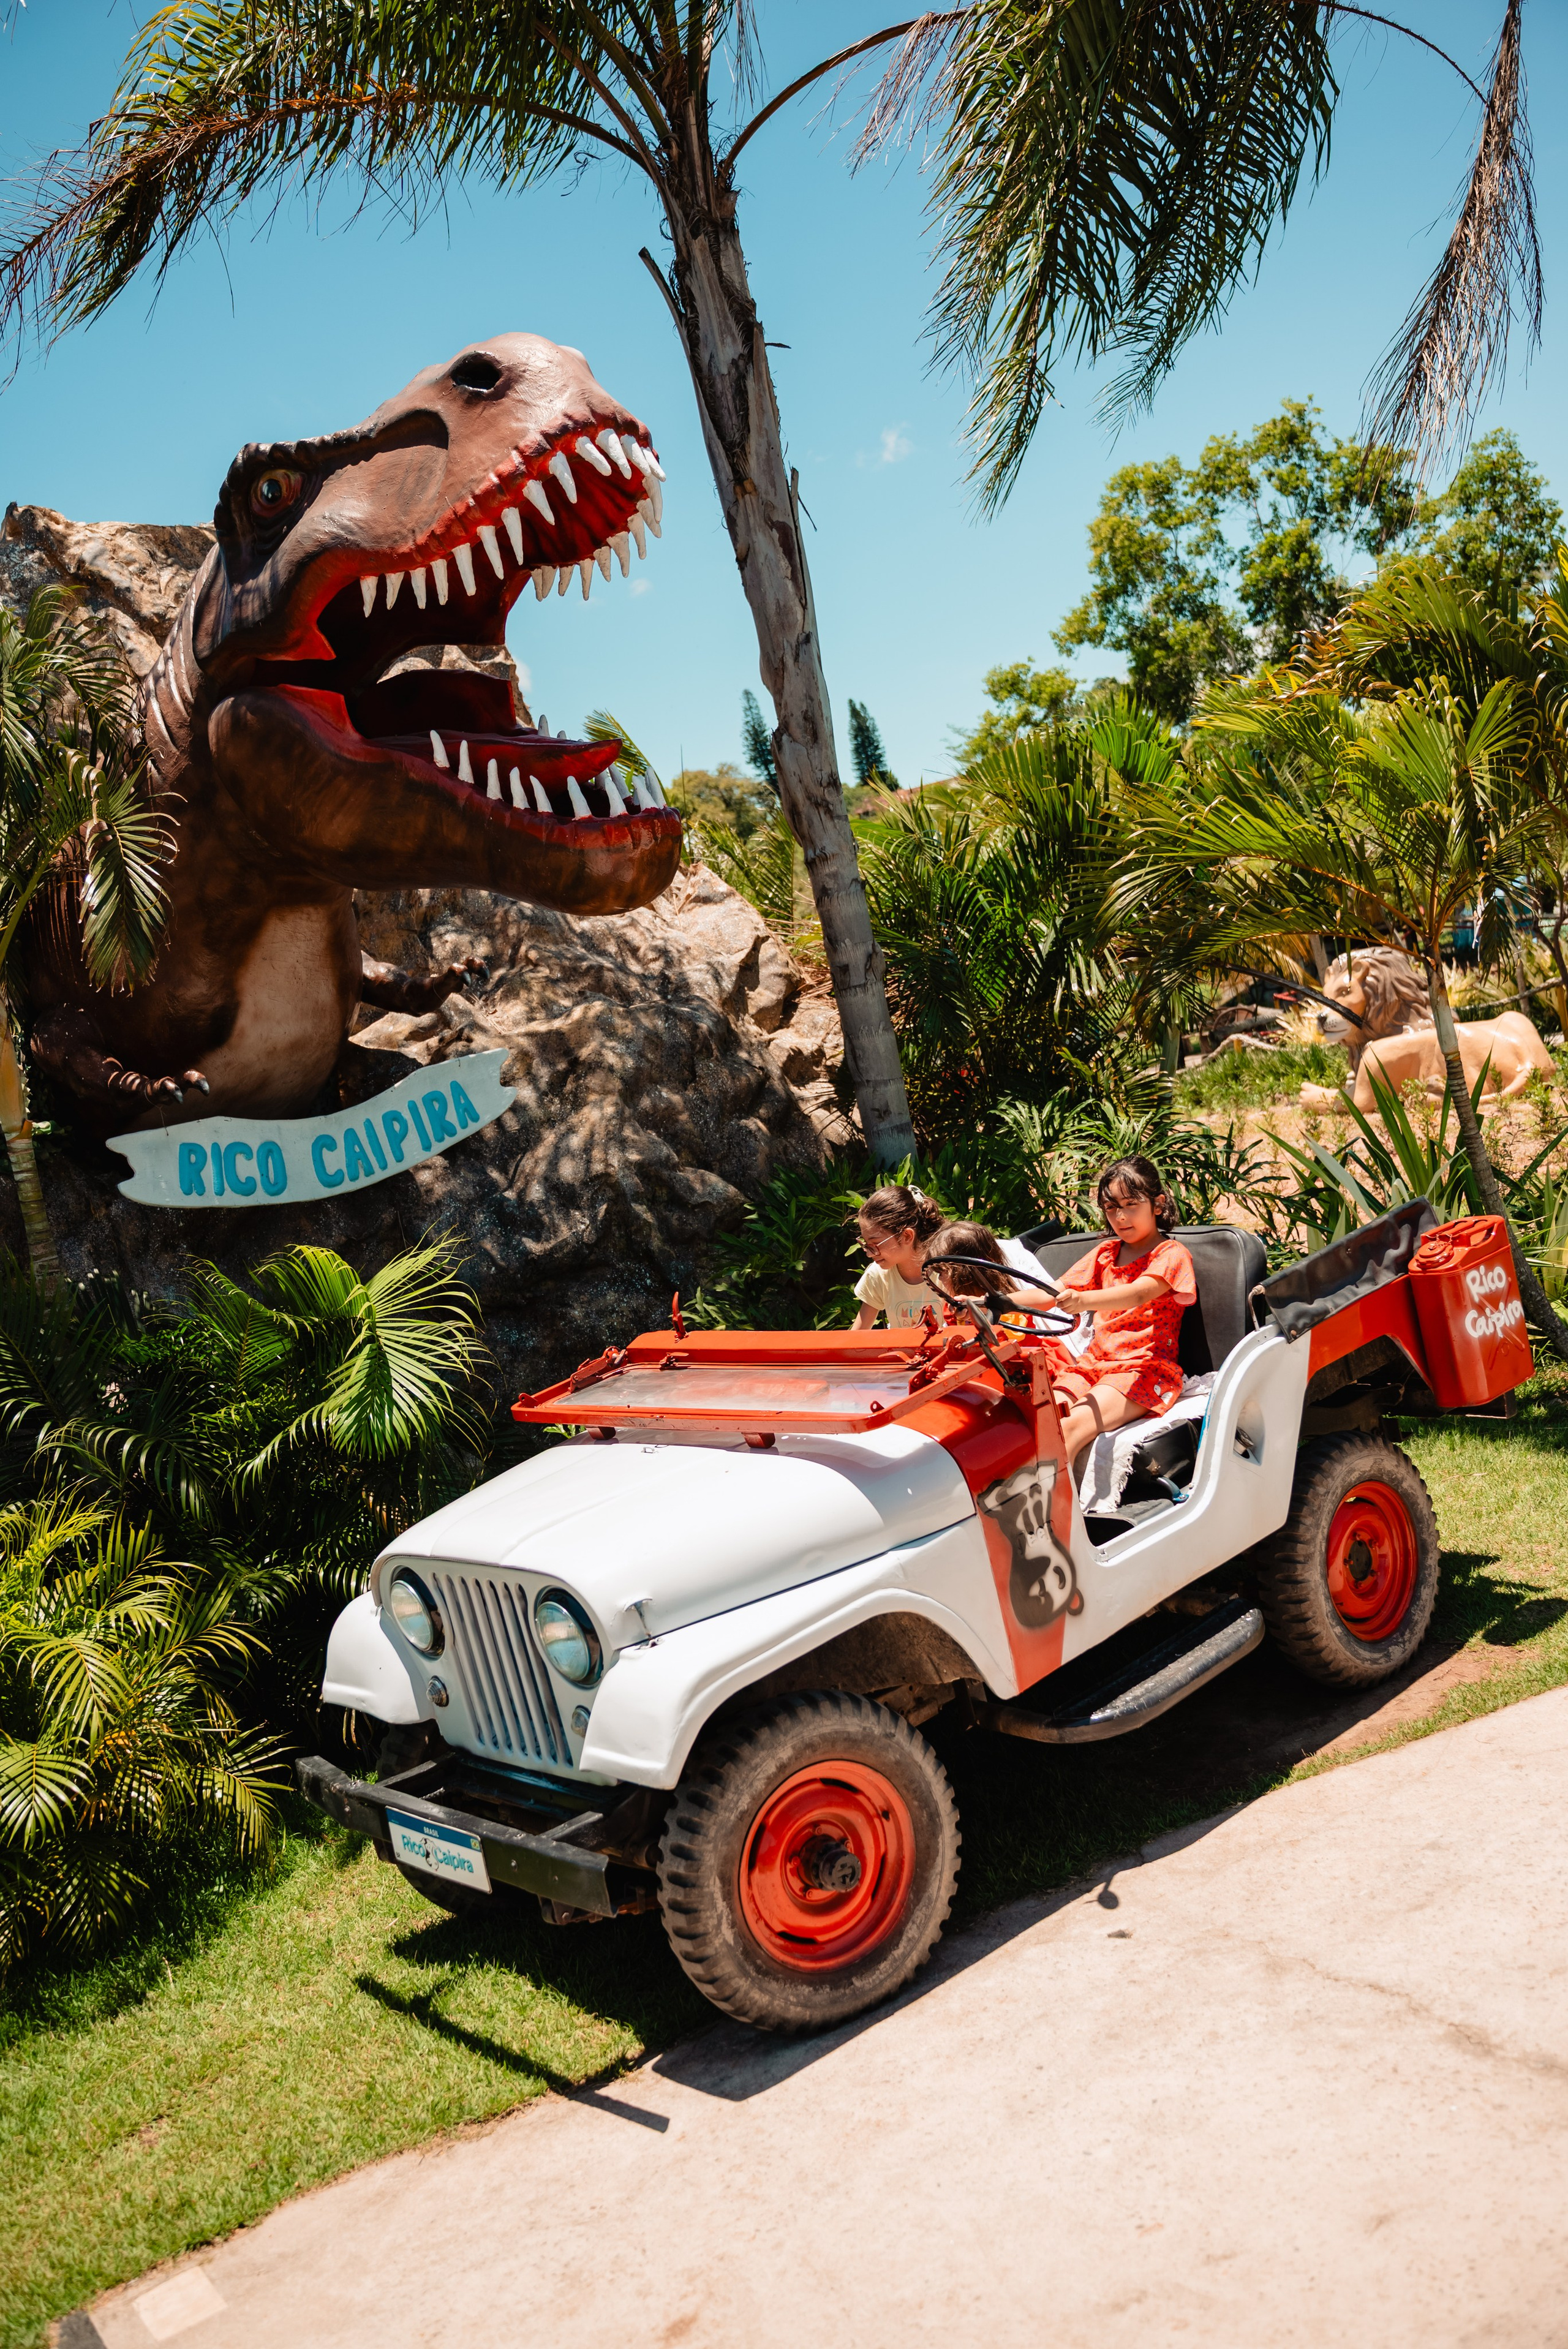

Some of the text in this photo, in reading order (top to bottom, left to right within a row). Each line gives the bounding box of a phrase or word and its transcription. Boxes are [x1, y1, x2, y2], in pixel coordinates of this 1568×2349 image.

[179, 1080, 480, 1196] RICO CAIPIRA
[1466, 1265, 1506, 1302] Rico
[424, 1827, 439, 1838] BRASIL
[401, 1834, 473, 1872] Rico Caipira
